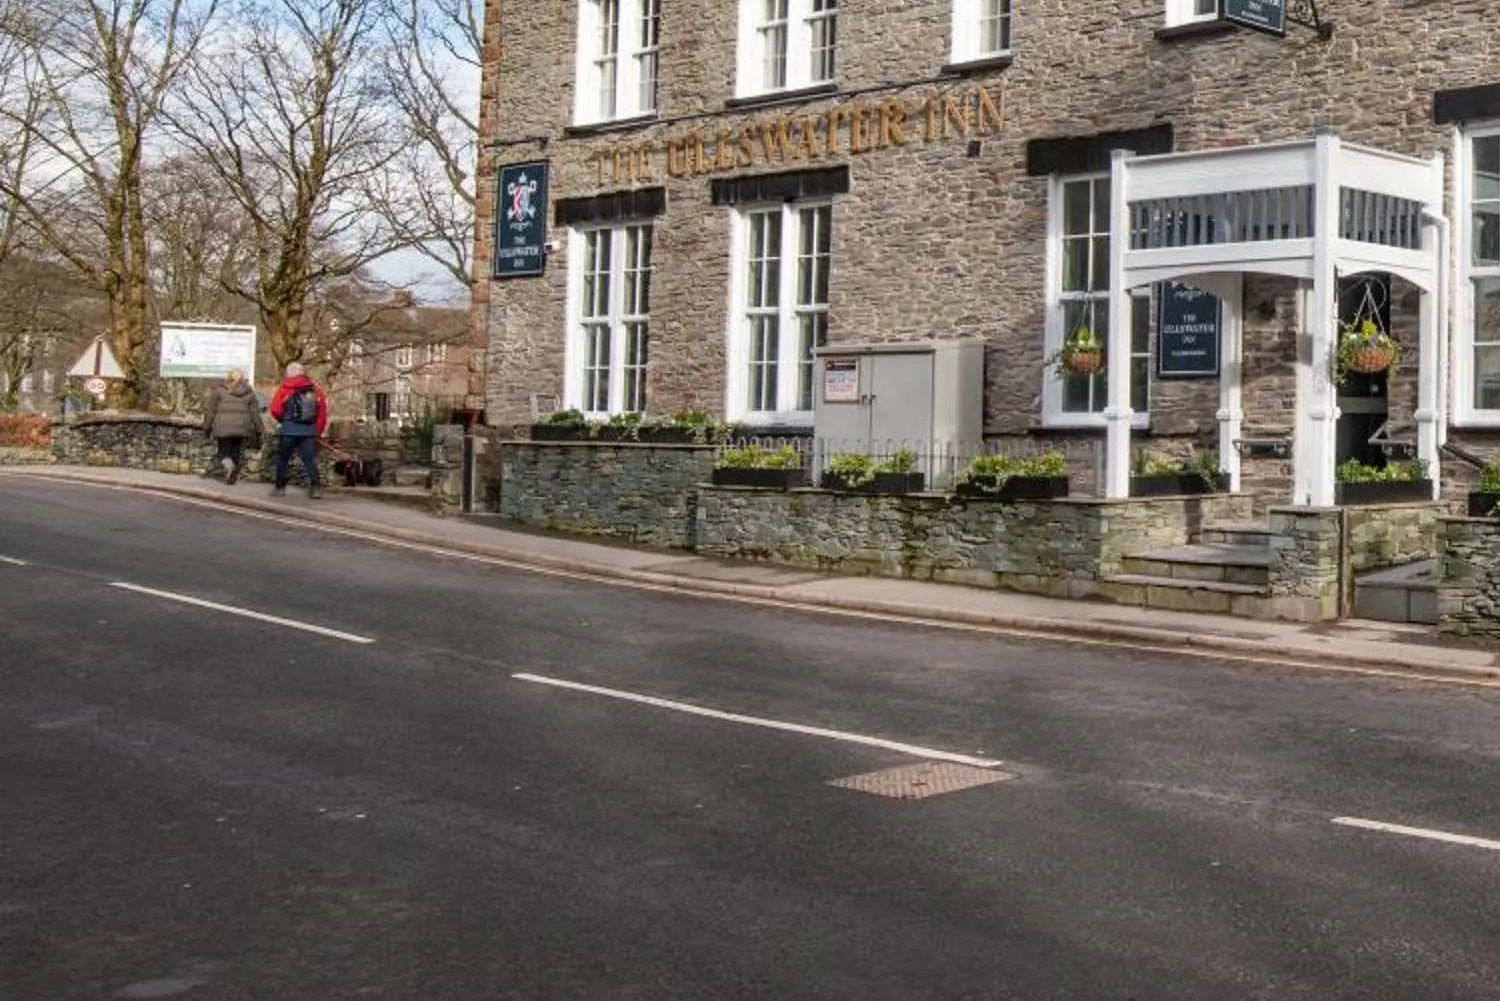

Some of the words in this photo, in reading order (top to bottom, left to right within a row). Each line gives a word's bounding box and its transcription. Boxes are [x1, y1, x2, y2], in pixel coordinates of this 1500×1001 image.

[594, 143, 653, 187] THE
[666, 97, 908, 177] ULLSWATER
[924, 81, 1006, 143] INN
